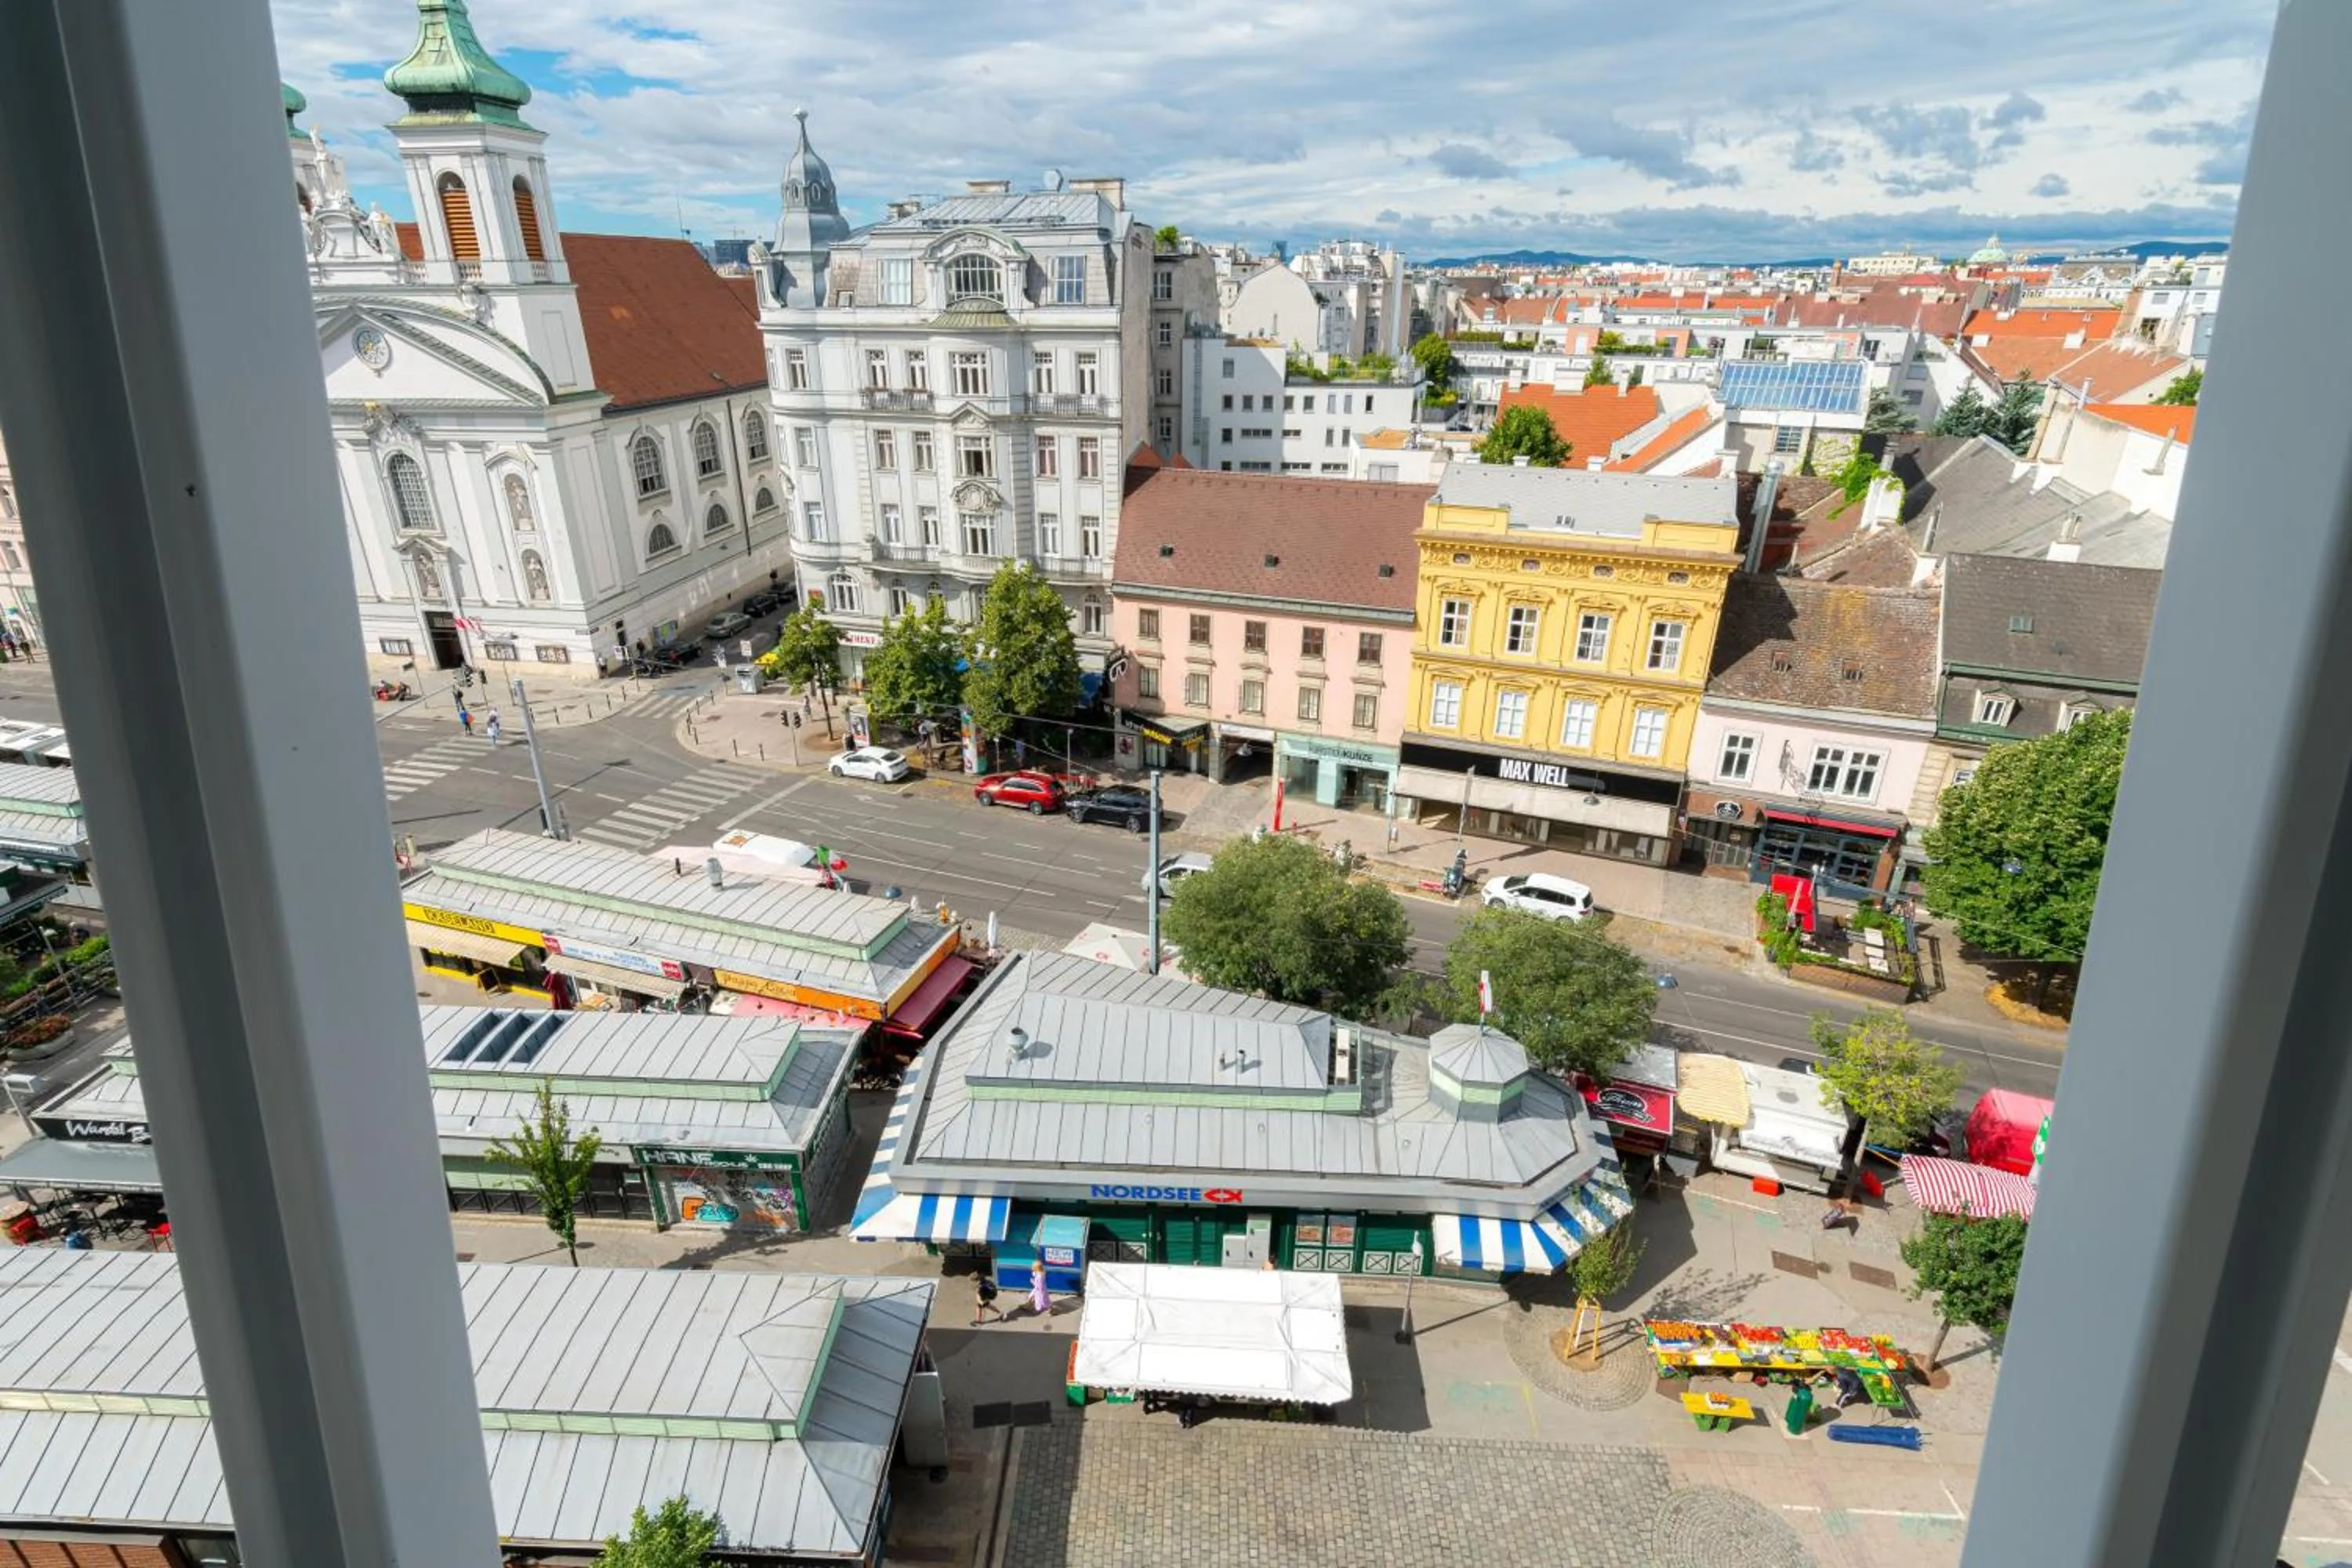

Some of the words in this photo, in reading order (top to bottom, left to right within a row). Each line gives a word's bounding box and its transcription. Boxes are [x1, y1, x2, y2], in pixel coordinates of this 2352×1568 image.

[1499, 758, 1532, 782] MAX
[1534, 763, 1569, 787] WELL
[642, 1149, 714, 1166] HANF
[1091, 1184, 1201, 1202] NORDSEE
